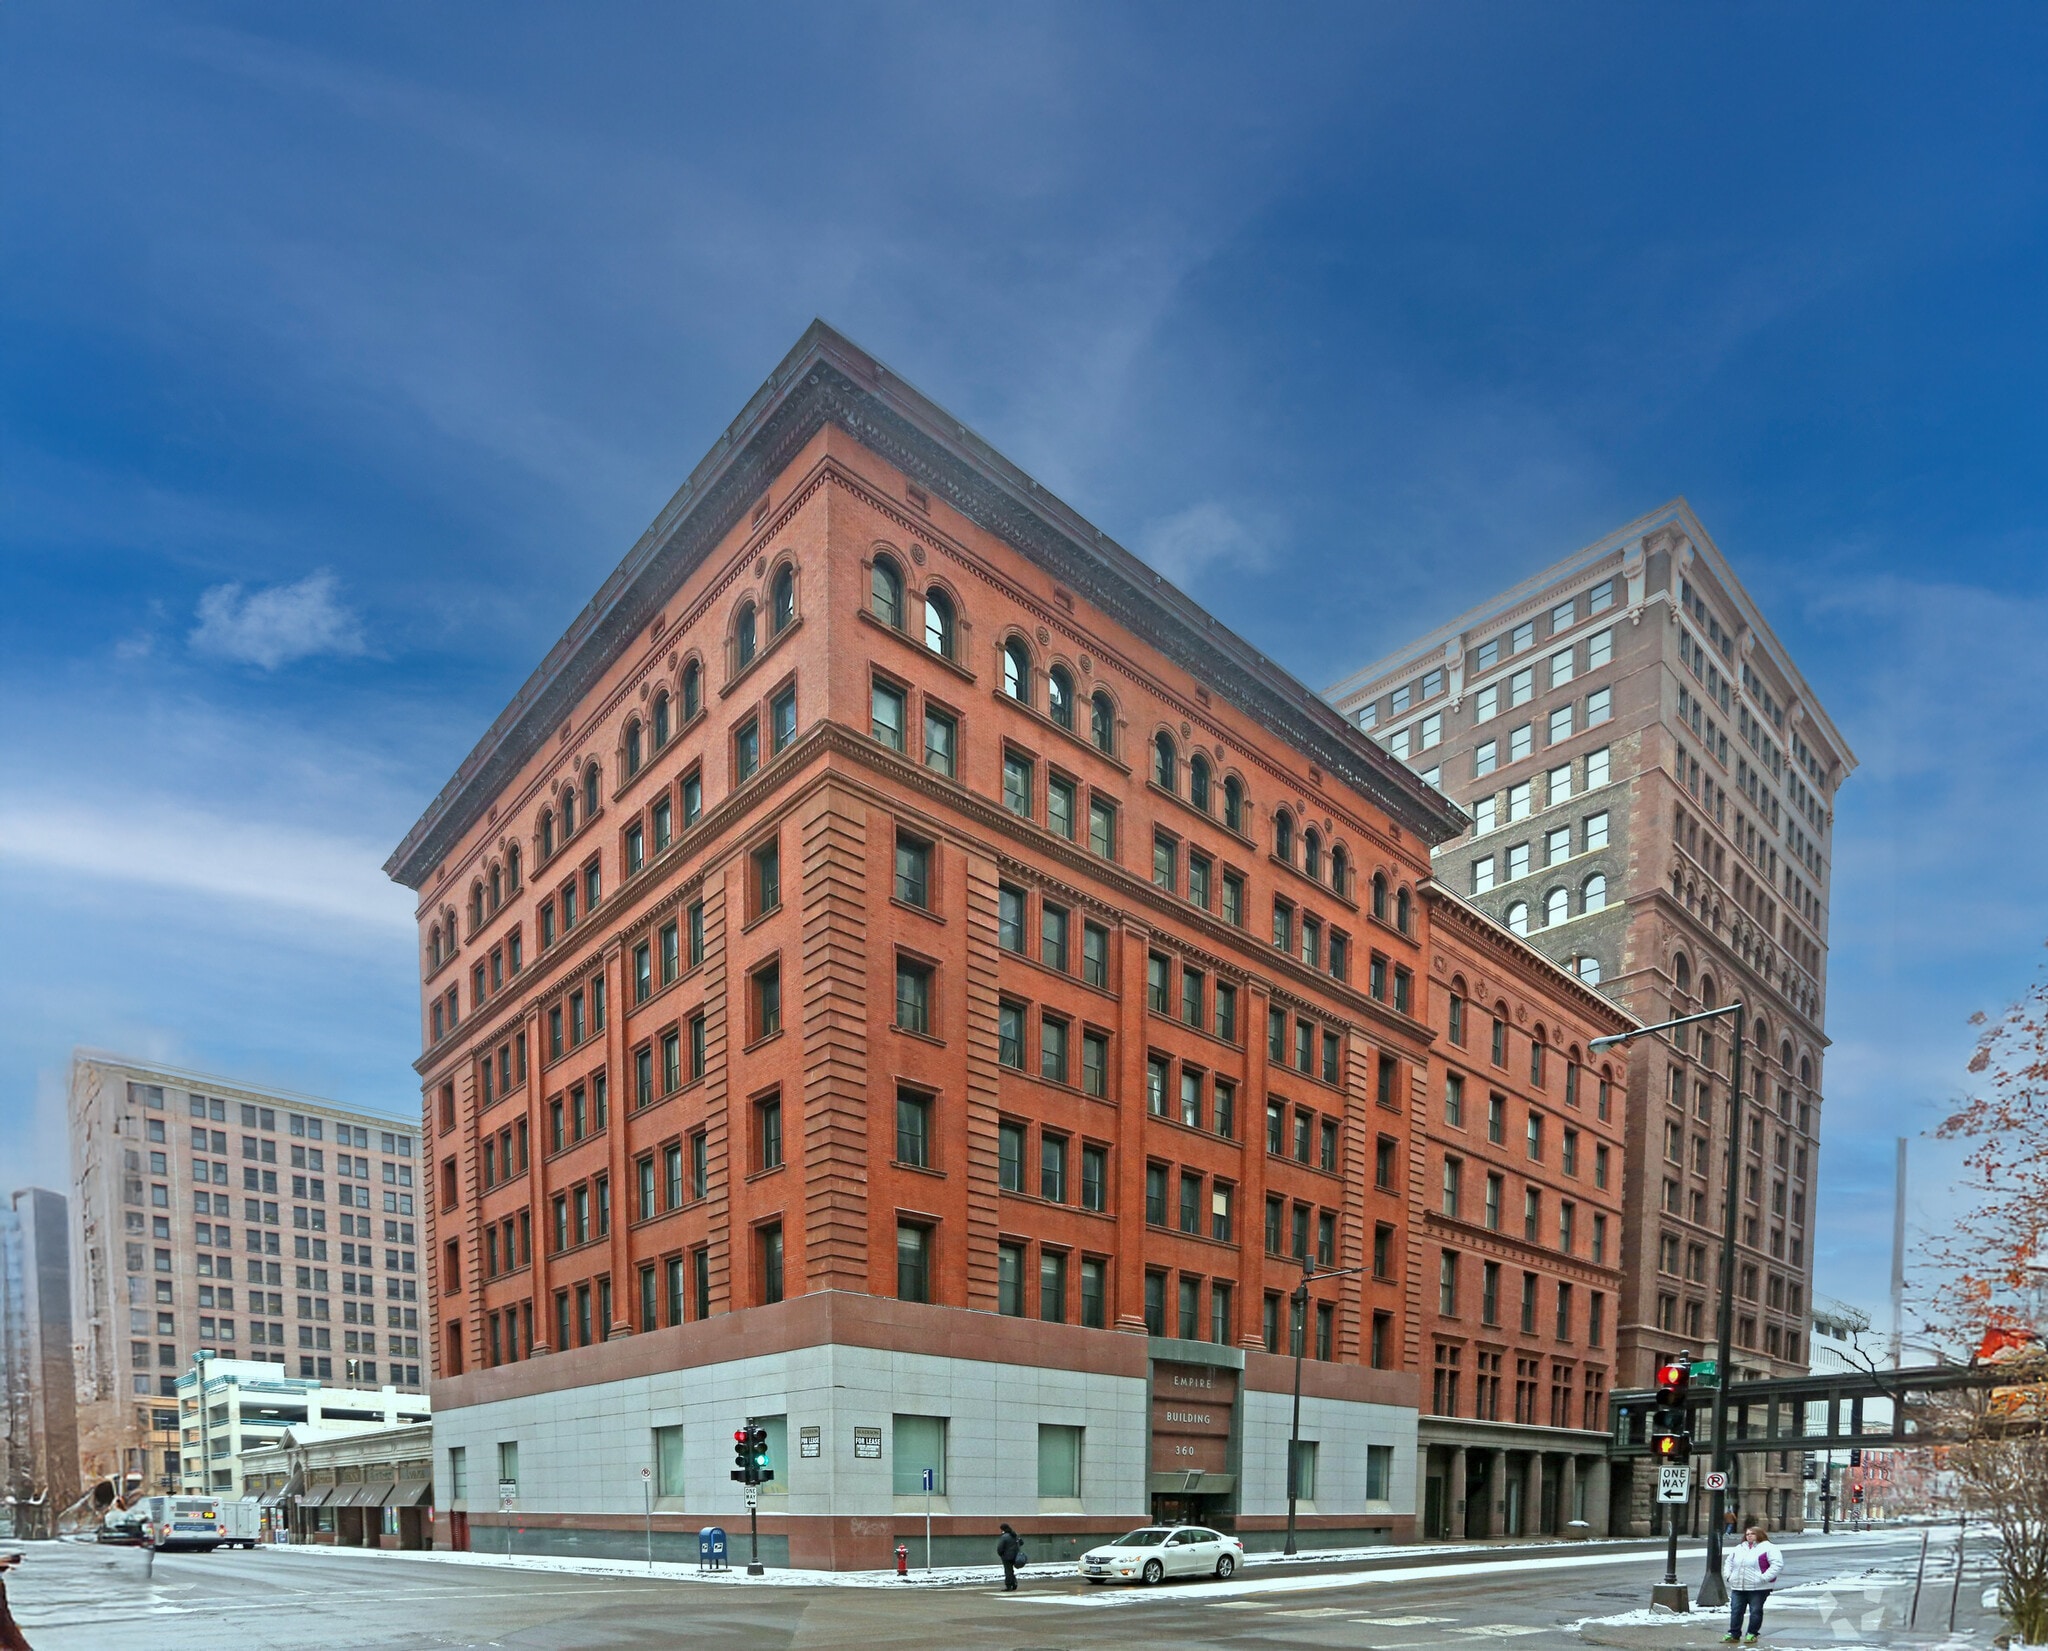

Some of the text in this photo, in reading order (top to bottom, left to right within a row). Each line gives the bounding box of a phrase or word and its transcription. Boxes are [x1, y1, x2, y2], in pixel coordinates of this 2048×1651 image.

[1174, 1376, 1211, 1388] EMPIRE
[1166, 1412, 1210, 1424] BUILDING
[856, 1437, 865, 1445] FOR
[1175, 1445, 1194, 1455] 360
[1663, 1469, 1686, 1478] ONE
[1662, 1479, 1686, 1488] WAY
